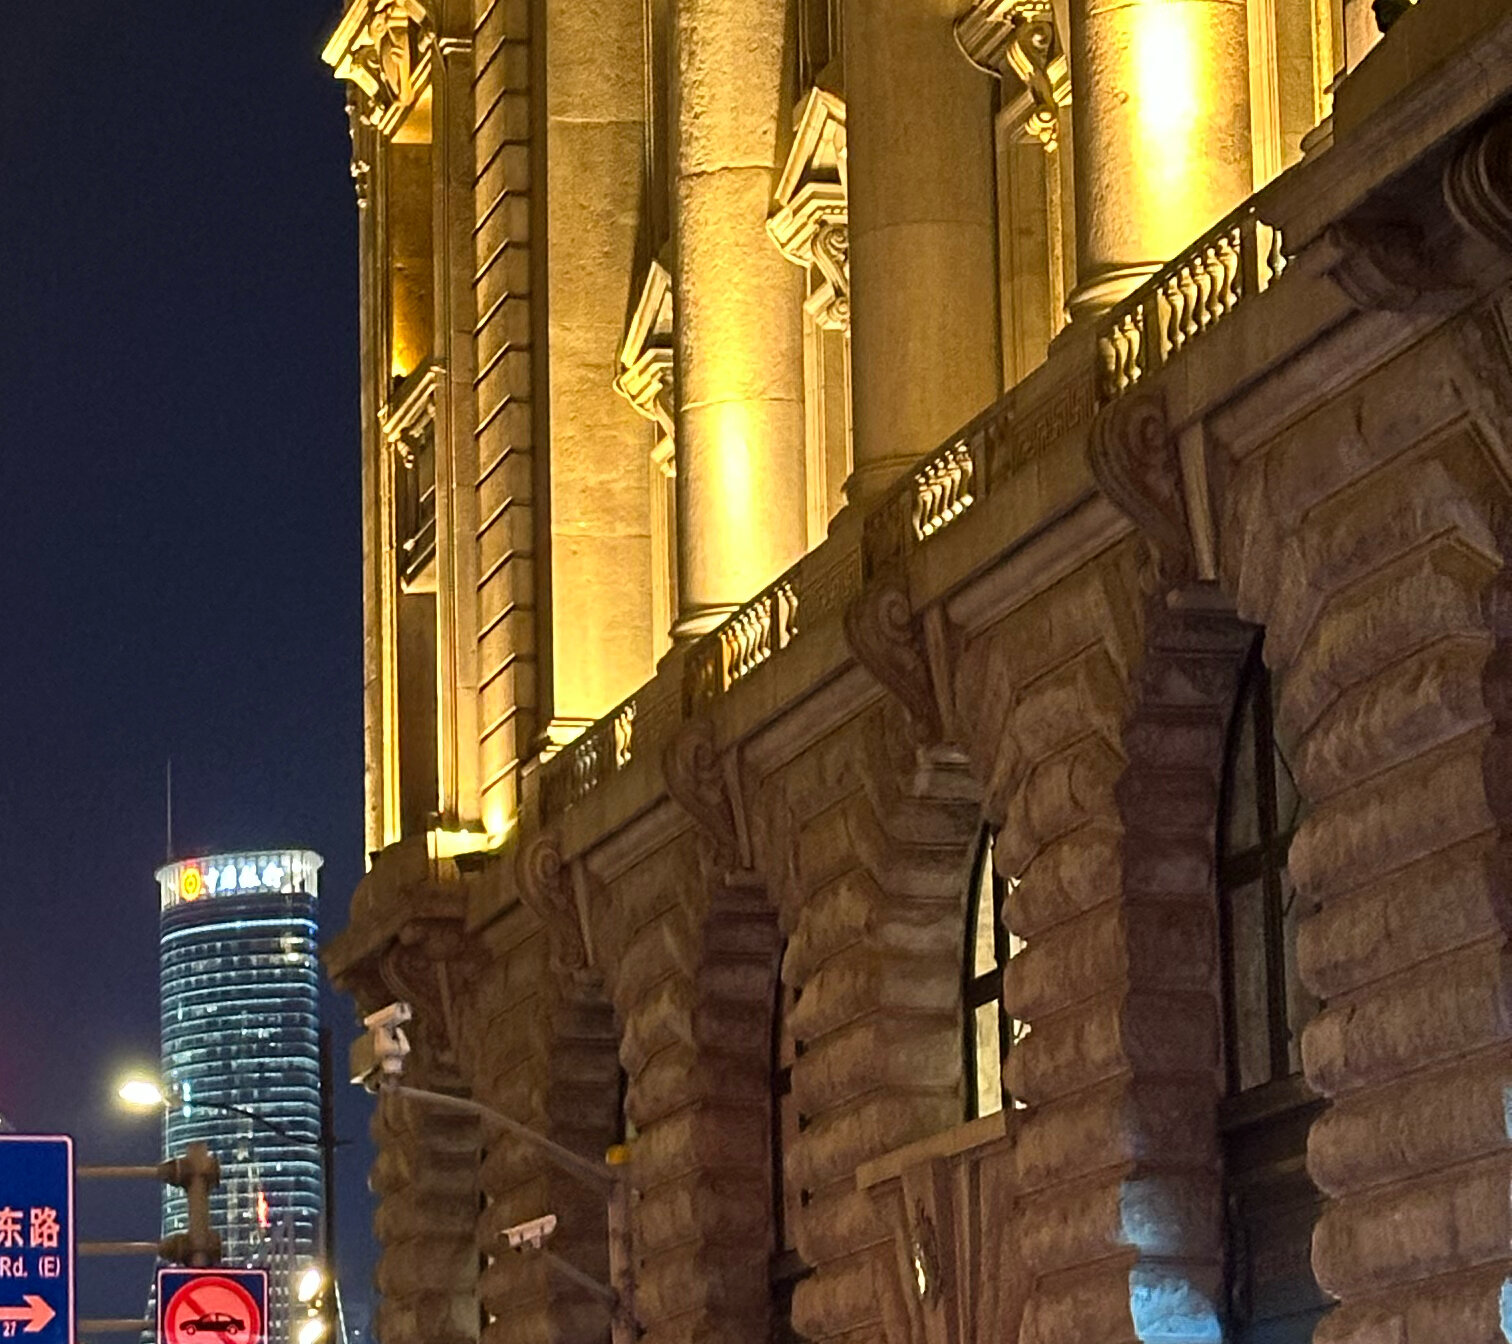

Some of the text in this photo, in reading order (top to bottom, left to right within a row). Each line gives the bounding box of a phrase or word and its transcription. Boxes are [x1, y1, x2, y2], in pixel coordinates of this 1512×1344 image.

[0, 1256, 28, 1277] Rd.
[38, 1256, 61, 1278] (E)
[2, 1321, 17, 1337] 27
